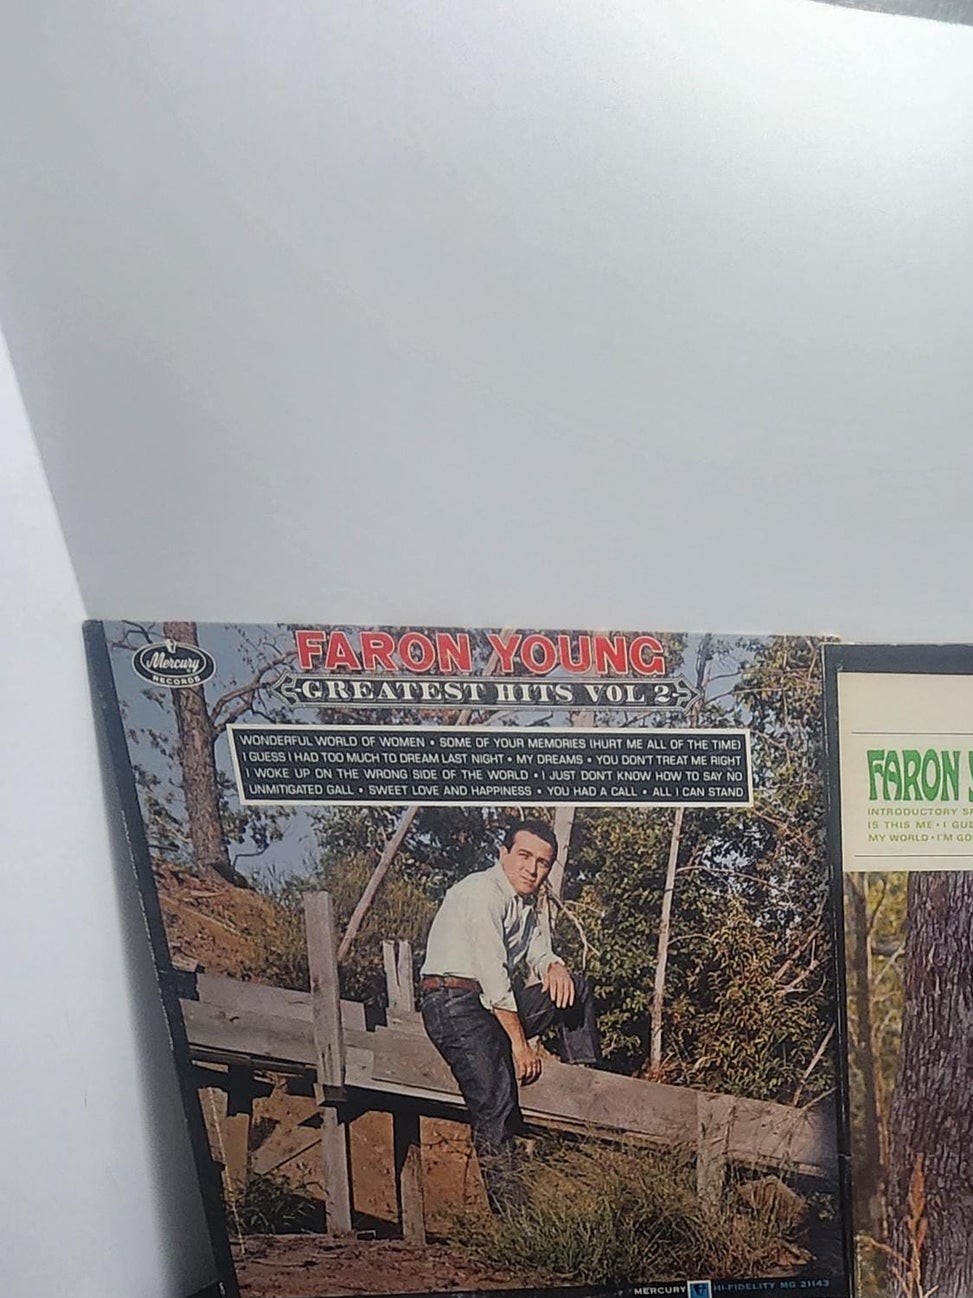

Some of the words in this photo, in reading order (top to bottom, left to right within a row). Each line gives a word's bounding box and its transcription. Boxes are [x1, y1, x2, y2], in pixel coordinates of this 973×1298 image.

[295, 630, 472, 673] FARON
[489, 634, 666, 675] YOUNG
[146, 651, 200, 673] Mercury
[152, 675, 201, 685] RECORDS
[301, 680, 484, 702] GREATEST
[498, 682, 573, 703] HITS
[585, 683, 645, 704] VOL
[239, 735, 313, 747] WONDERFUL
[315, 736, 357, 747] WORLD
[362, 736, 376, 747] OF
[379, 736, 425, 748] WOMEN
[439, 737, 472, 748] SOME
[476, 737, 491, 748] OF
[493, 737, 524, 749] YOUR
[528, 738, 586, 749] MEMORIES
[589, 738, 623, 749] (HURT
[626, 738, 643, 750] ME
[647, 739, 666, 750] ALL
[670, 739, 684, 750] OF
[687, 739, 708, 750] THE
[711, 739, 742, 751] TIME)
[867, 749, 960, 801] FARON
[249, 784, 323, 795] UNMITIGATED
[327, 785, 354, 796] GALL
[369, 785, 407, 796] SWEET
[412, 785, 439, 796] LOVE
[443, 785, 467, 796] AND
[471, 785, 532, 796] HAPPINESS
[547, 786, 569, 797] YOU
[573, 786, 596, 797] HAD
[611, 786, 638, 797] CALL
[652, 786, 671, 797] ALL
[682, 787, 705, 797] CAN
[708, 787, 743, 798] STAND
[868, 808, 957, 816] INTRODUCTORY
[868, 834, 891, 842] MY
[895, 834, 928, 842] WORLD
[937, 834, 953, 842] I'M
[634, 1287, 687, 1295] MERCURY
[713, 1281, 775, 1291] HI-FIDELITY
